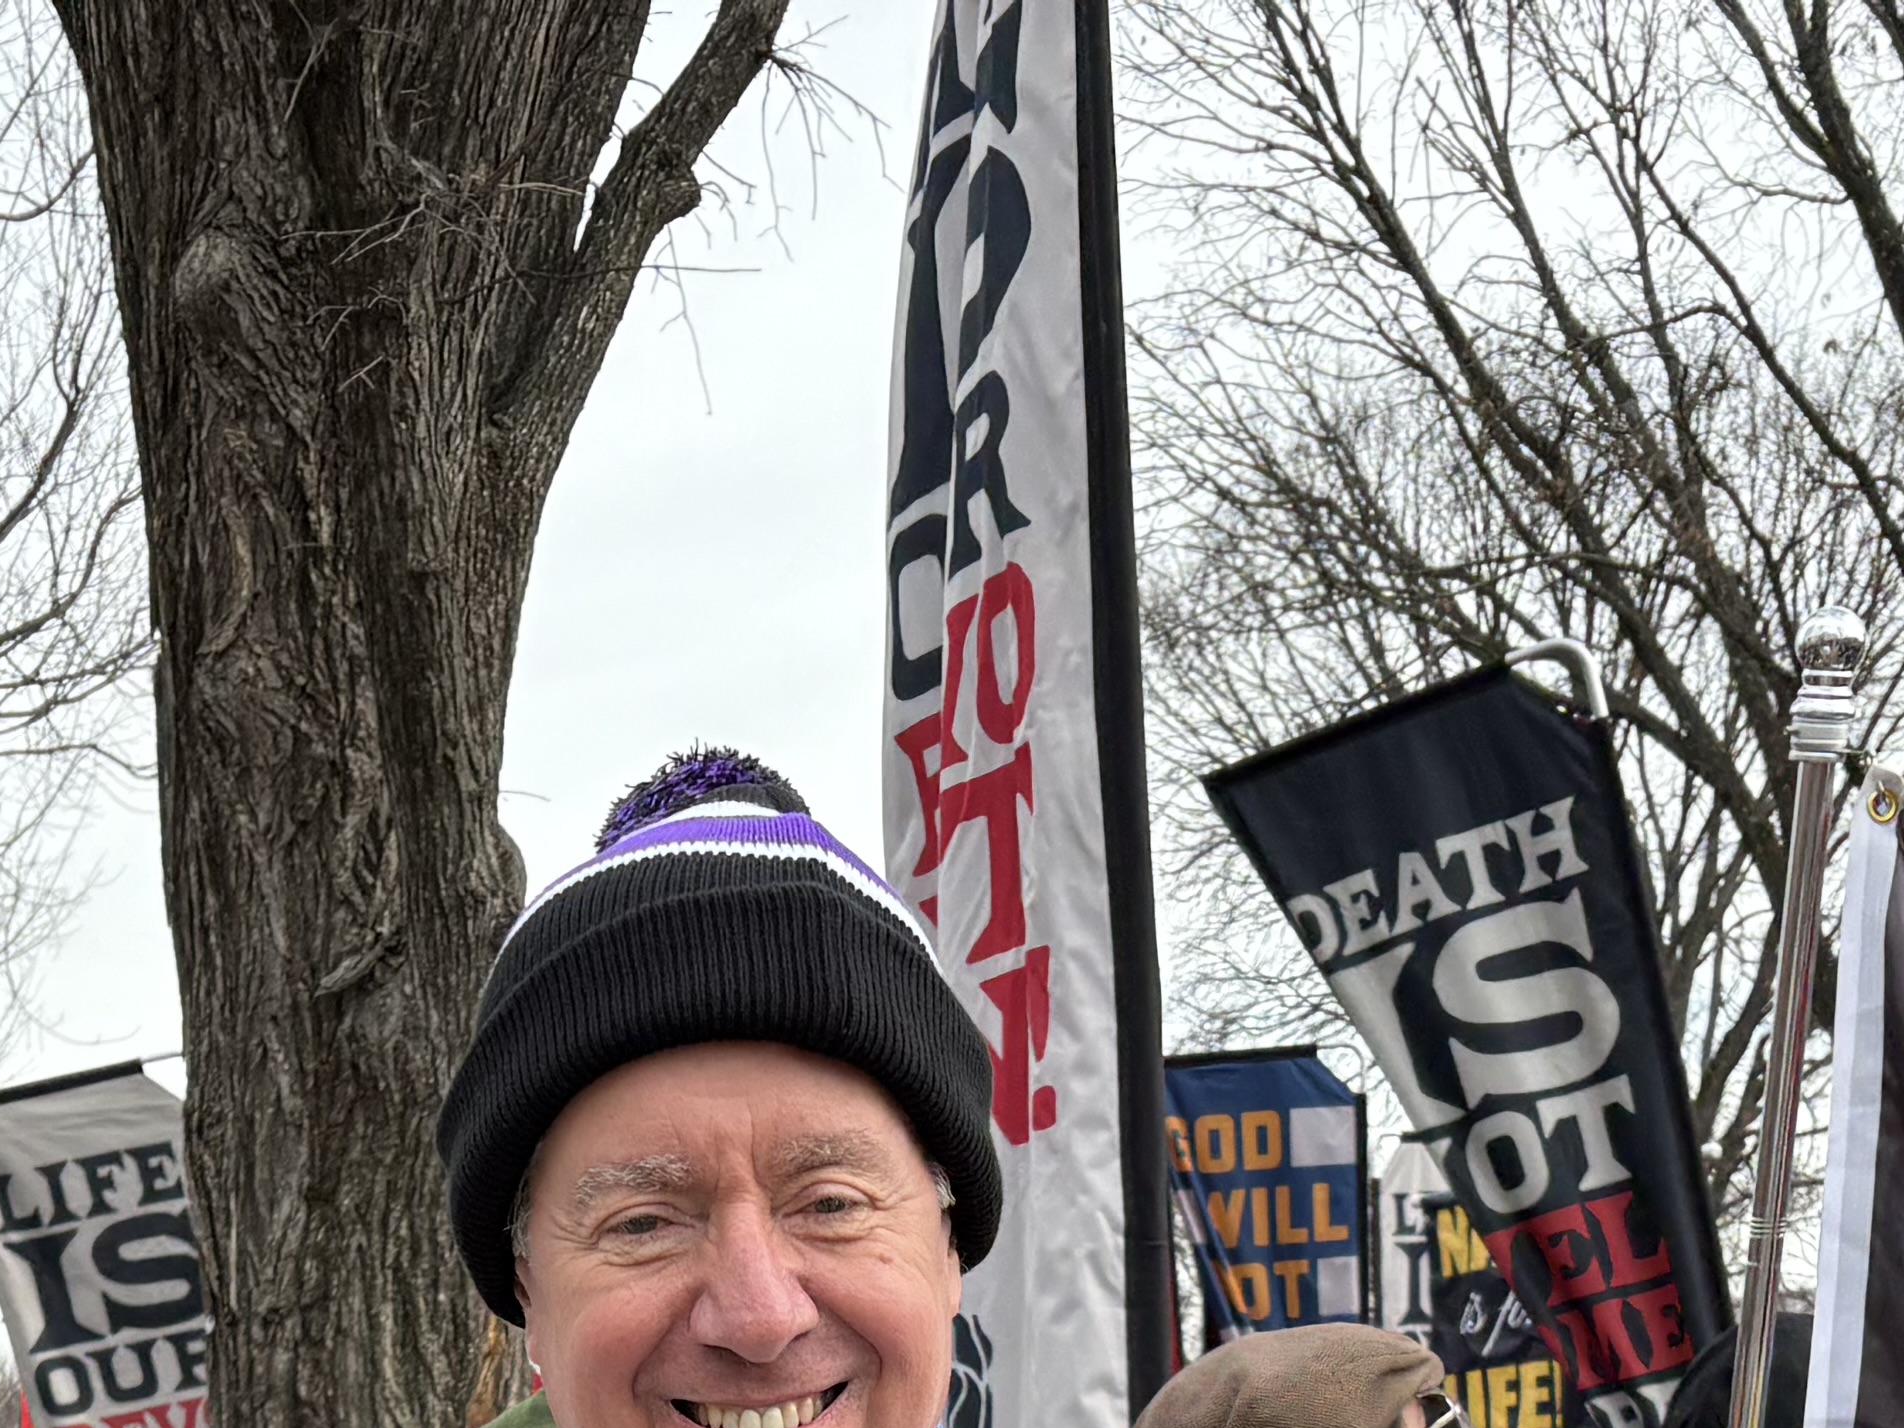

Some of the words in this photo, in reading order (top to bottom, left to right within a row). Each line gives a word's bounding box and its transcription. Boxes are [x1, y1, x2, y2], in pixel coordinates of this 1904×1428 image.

[1288, 797, 1588, 963] DEATH
[1329, 886, 1621, 1130] IS
[1164, 1109, 1284, 1174] GOD
[1466, 1075, 1636, 1214] OT
[4, 1205, 205, 1352] IS
[1207, 1182, 1350, 1249] WILL
[1212, 1258, 1310, 1321] OT
